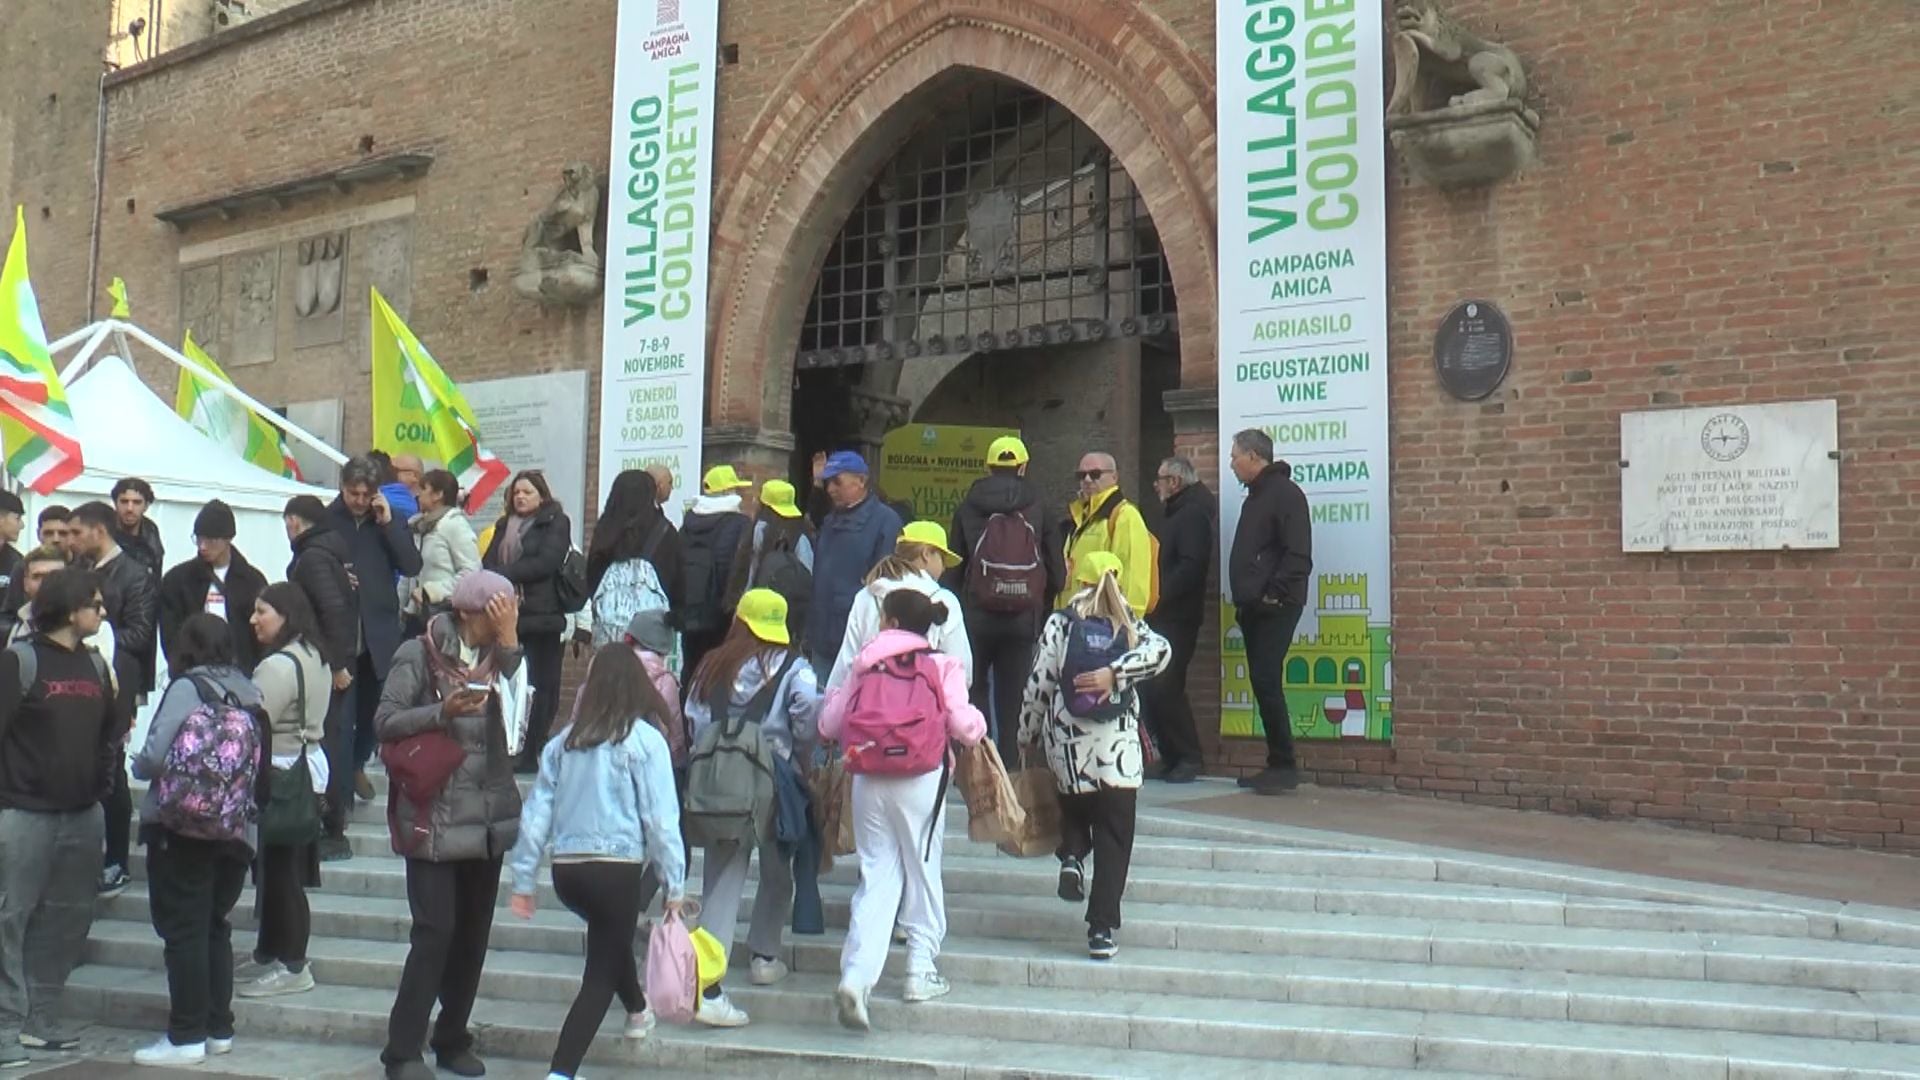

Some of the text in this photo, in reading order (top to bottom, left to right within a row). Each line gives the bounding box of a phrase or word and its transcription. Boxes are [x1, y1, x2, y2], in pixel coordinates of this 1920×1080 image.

[643, 31, 690, 52] CAMPAGNA
[651, 45, 681, 61] AMICA
[660, 62, 700, 321] COLDIRETTI
[623, 95, 662, 328] VILLAGGIO
[1249, 248, 1354, 278] CAMPAGNA
[1271, 276, 1332, 300] AMICA
[1253, 313, 1352, 341] AGRIASILO
[640, 336, 670, 354] 7-8-9
[624, 353, 685, 374] NOVEMBRE
[1237, 352, 1369, 382] DEGUSTAZIONI
[1277, 381, 1327, 402] WINE
[627, 405, 679, 423] E SABATO
[621, 424, 683, 442] 9.00-22.00
[1260, 420, 1347, 444] NCONTRI
[888, 455, 928, 465] BOLOGNA
[1293, 461, 1370, 484] STAMPA
[1664, 468, 1791, 481] AGLI INTERNATI MILITARI
[1758, 480, 1799, 490] NAZISTI
[1311, 502, 1370, 524] MENTI
[1714, 506, 1784, 517] ANNIVERSARIO
[1694, 521, 1754, 530] LIBERAZIONE
[1705, 534, 1748, 542] BOLOGNA
